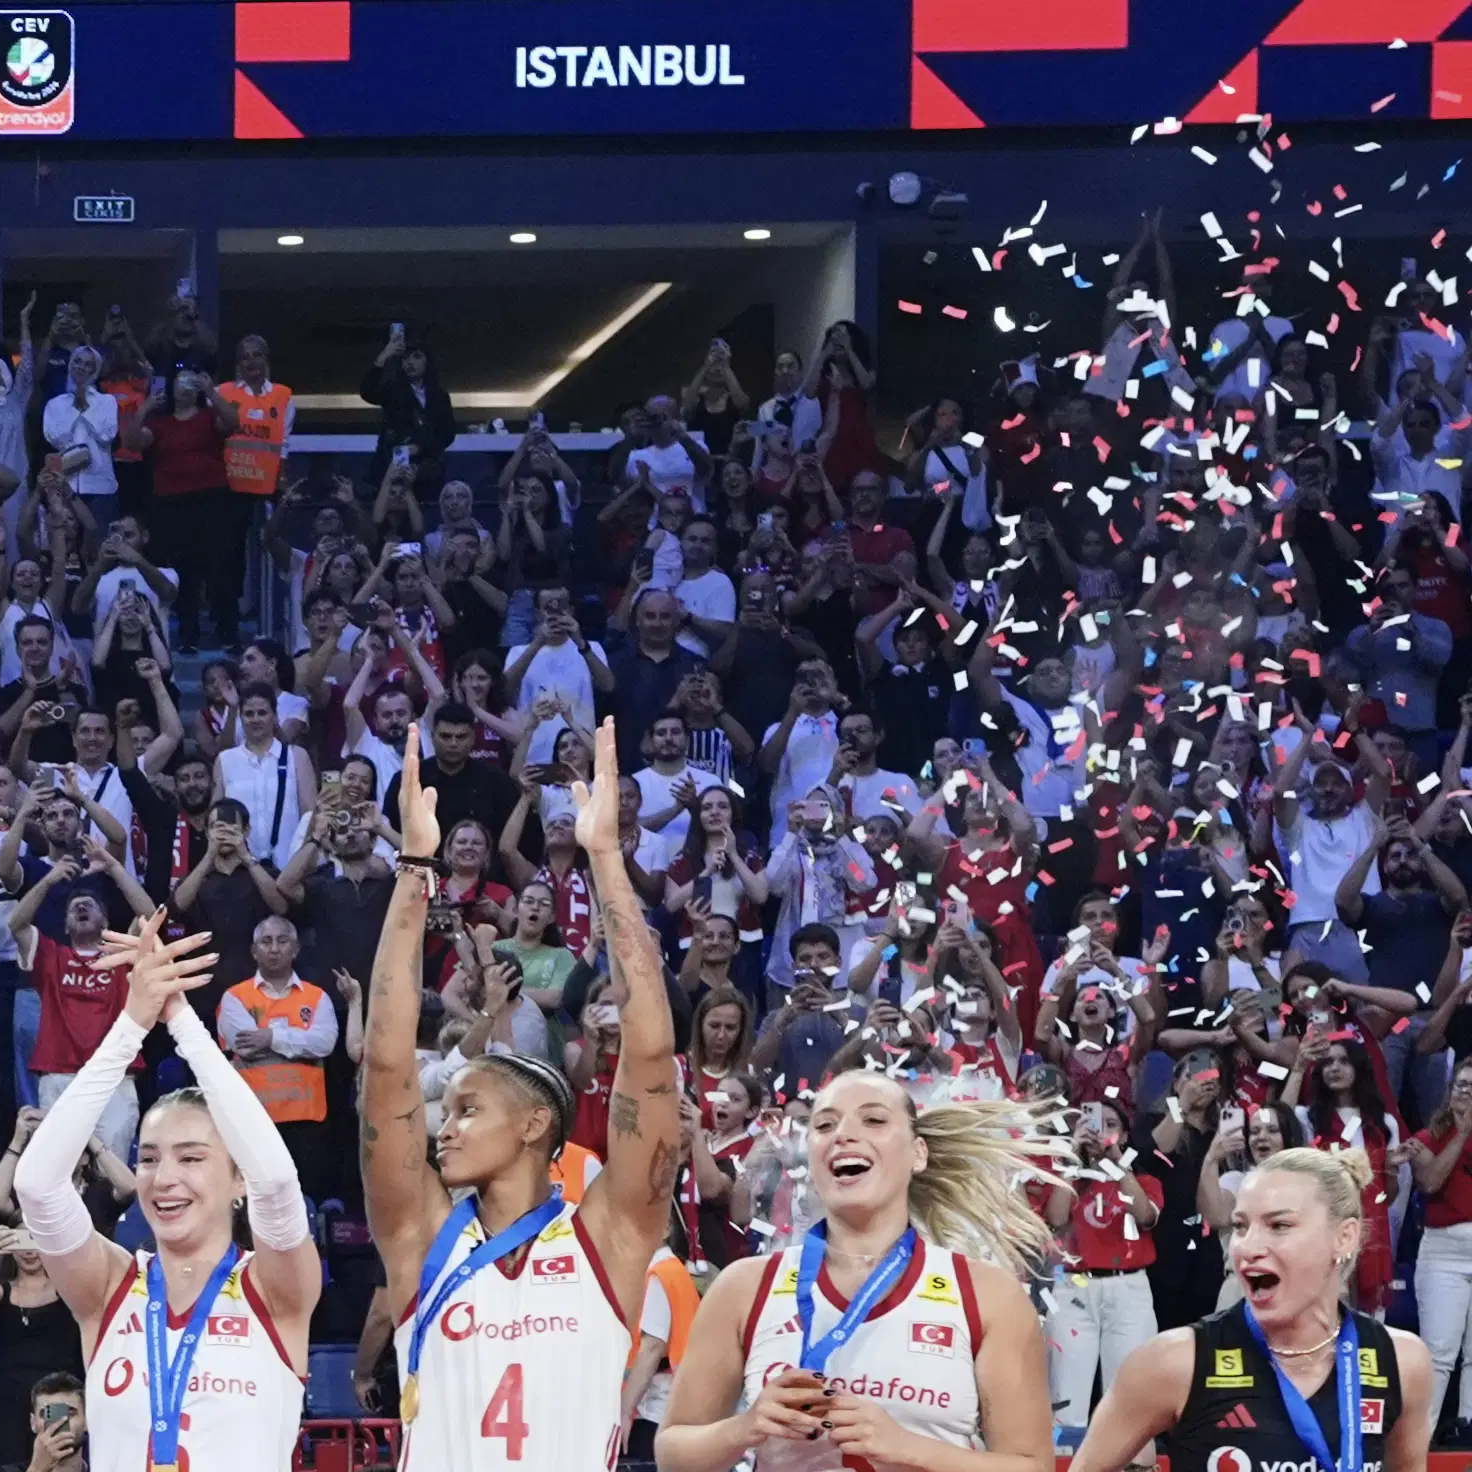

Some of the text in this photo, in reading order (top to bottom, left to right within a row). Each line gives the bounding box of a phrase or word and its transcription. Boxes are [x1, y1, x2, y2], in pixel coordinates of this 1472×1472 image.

[11, 18, 50, 33] CEV
[515, 44, 746, 88] ISTANBUL
[83, 200, 125, 210] EXIT
[931, 1276, 946, 1289] S
[920, 1344, 945, 1354] TUR
[1221, 1355, 1236, 1370] S
[480, 1363, 530, 1462] 4
